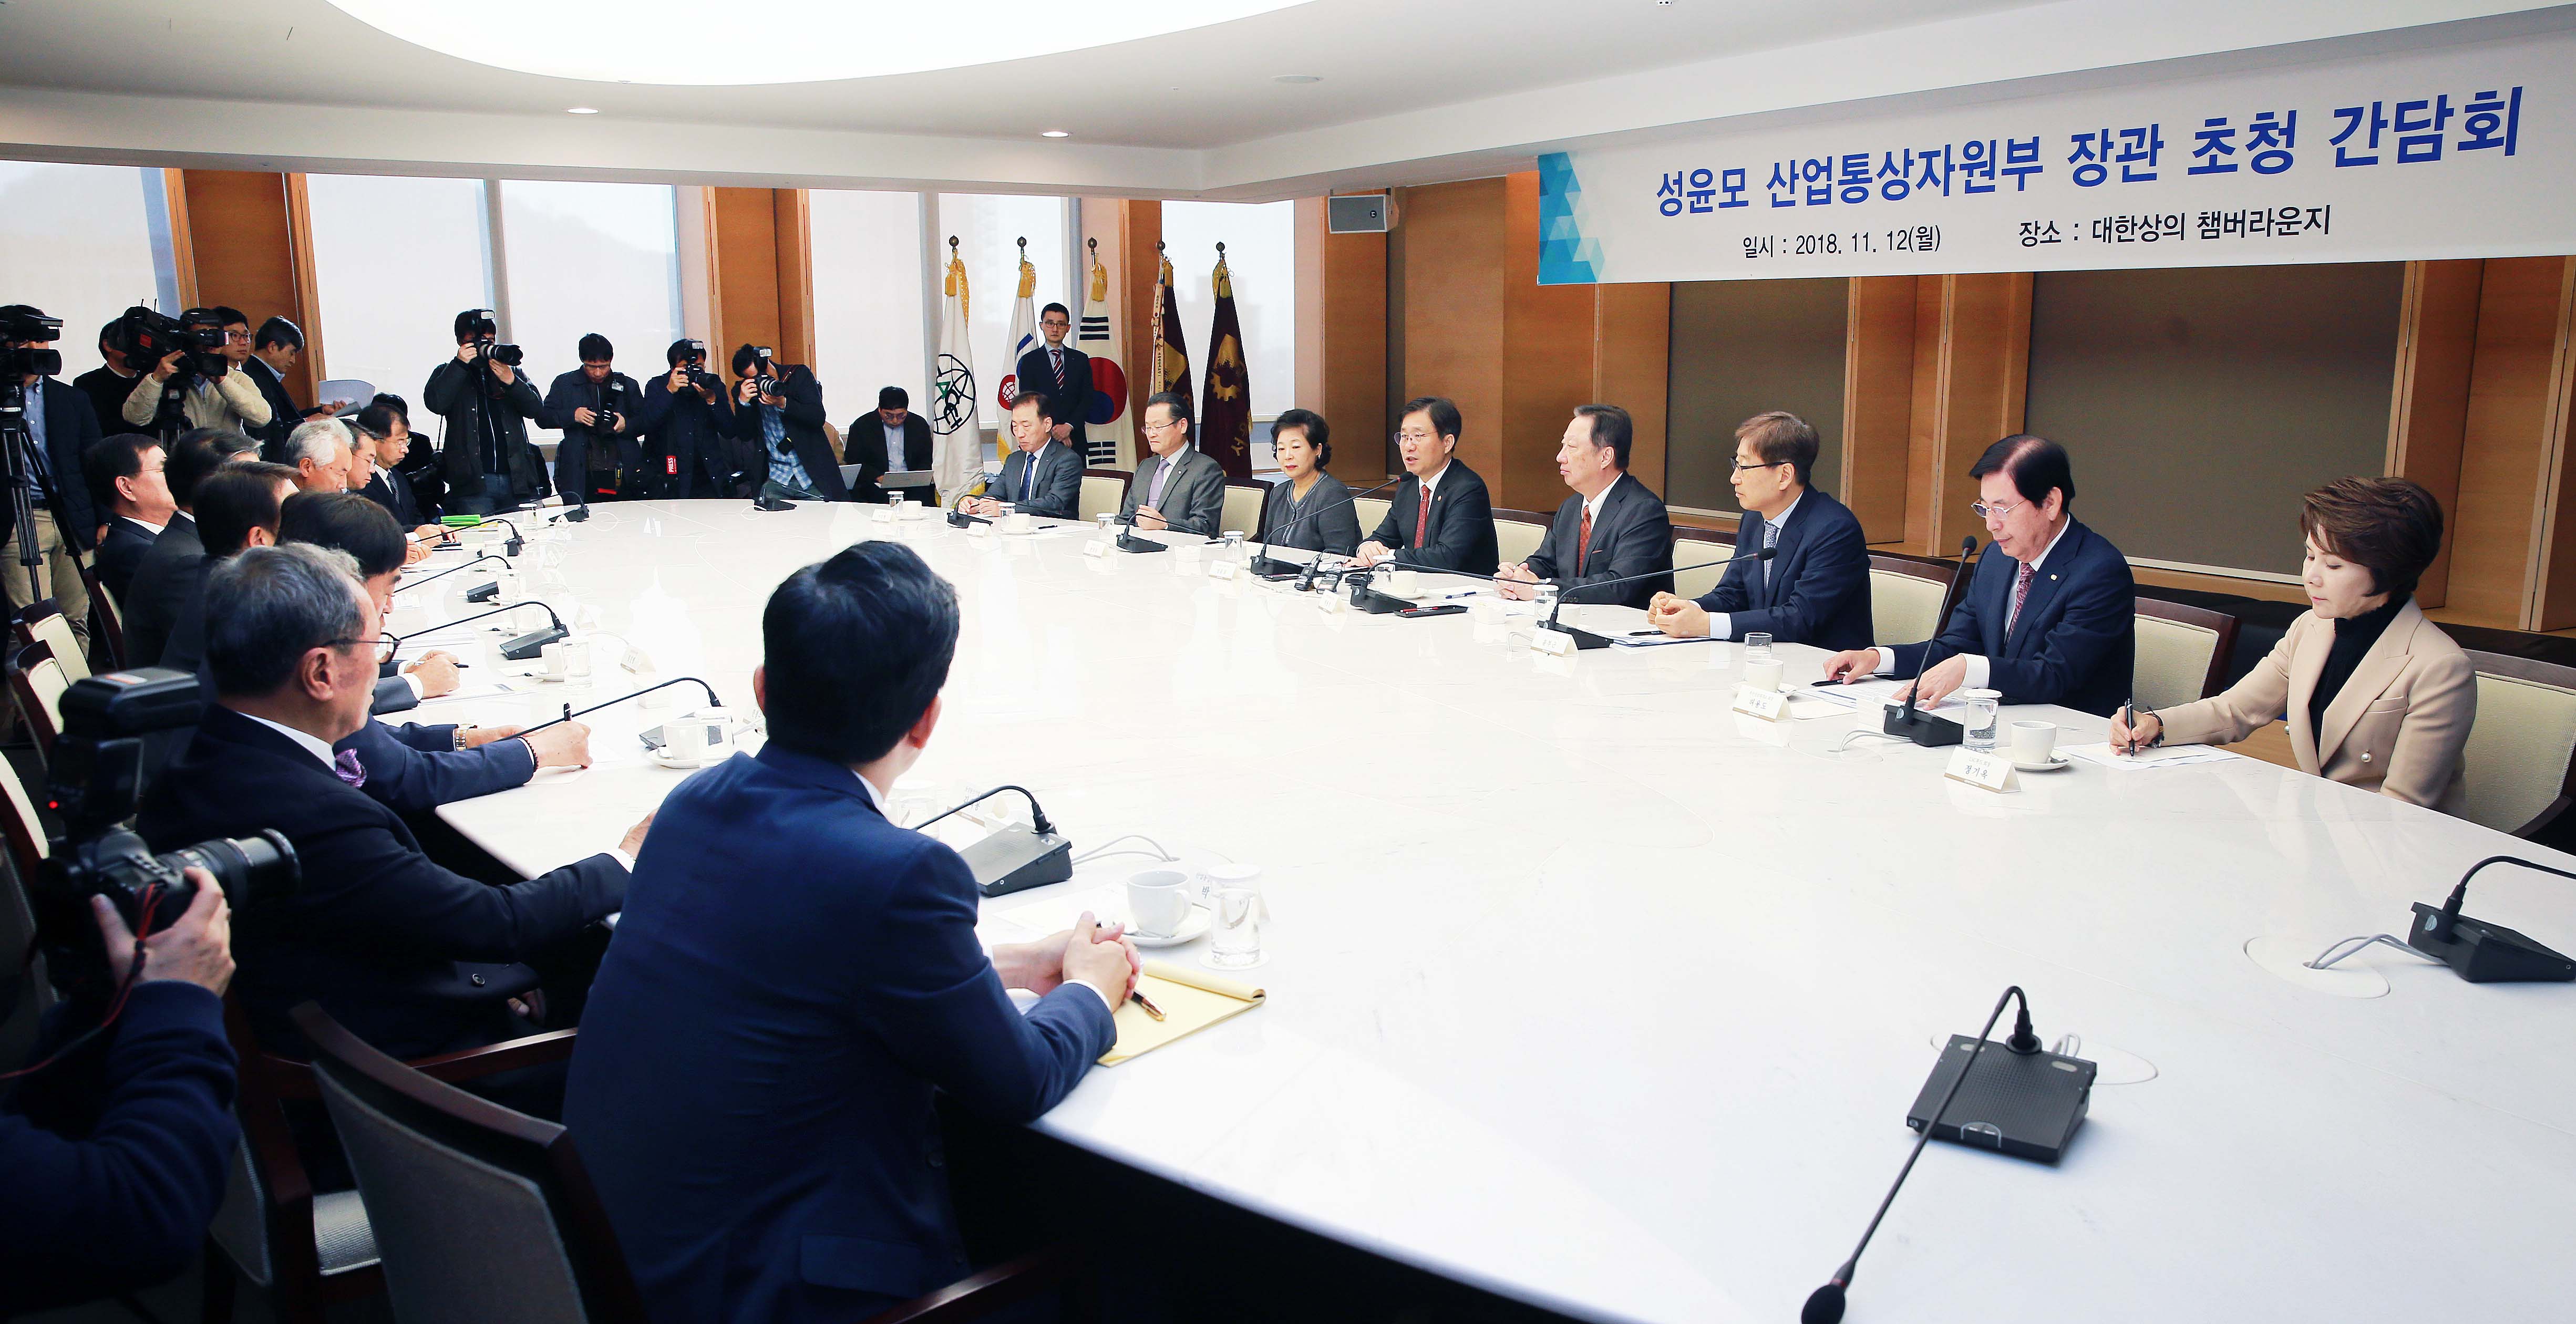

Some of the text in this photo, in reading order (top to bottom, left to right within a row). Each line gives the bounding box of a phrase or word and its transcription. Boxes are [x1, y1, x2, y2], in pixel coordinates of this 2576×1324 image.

[1657, 87, 2523, 216] 성윤모 산업통상자원부 장관 초청 간담회
[1743, 235, 1774, 258] 일시
[1796, 233, 1842, 255] 2018.
[1852, 232, 1877, 253] 11.
[1887, 225, 1941, 253] 12(월)
[2019, 220, 2062, 247] 장소
[2092, 212, 2186, 244] 대한상의
[2197, 204, 2332, 240] 챔버라운지
[1964, 764, 1988, 780] 정기옥
